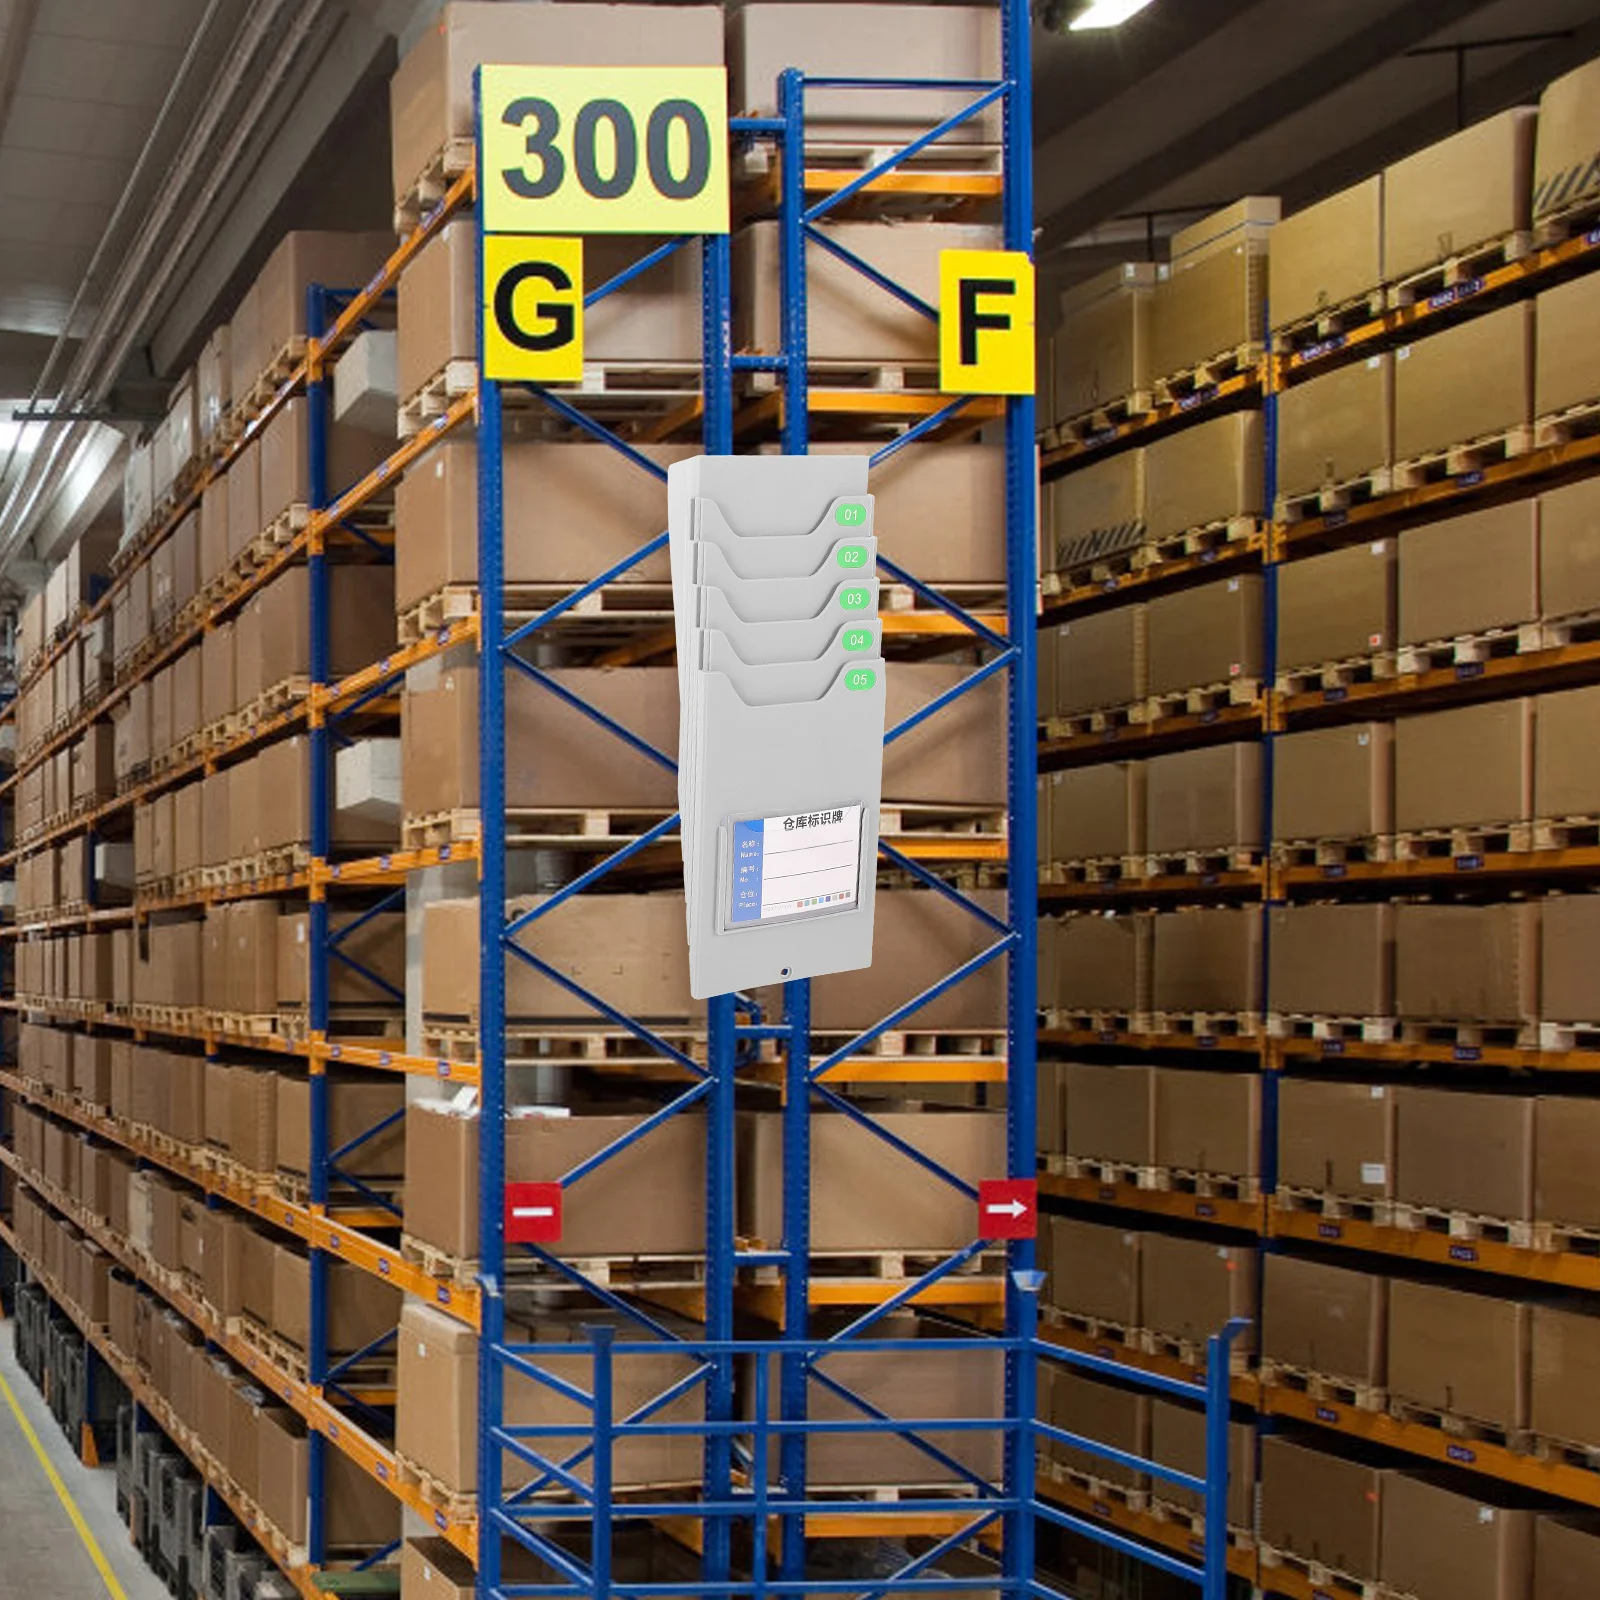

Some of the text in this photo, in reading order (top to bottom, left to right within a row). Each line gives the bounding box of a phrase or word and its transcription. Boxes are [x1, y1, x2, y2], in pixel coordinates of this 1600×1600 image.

[502, 97, 711, 200] 300
[493, 261, 574, 352] G
[959, 279, 1016, 365] F
[844, 509, 858, 520] 01
[844, 551, 859, 563] 02
[847, 593, 862, 605] 03
[850, 634, 865, 646] 04
[853, 674, 868, 686] 05
[783, 810, 844, 831] 仓库标识牌
